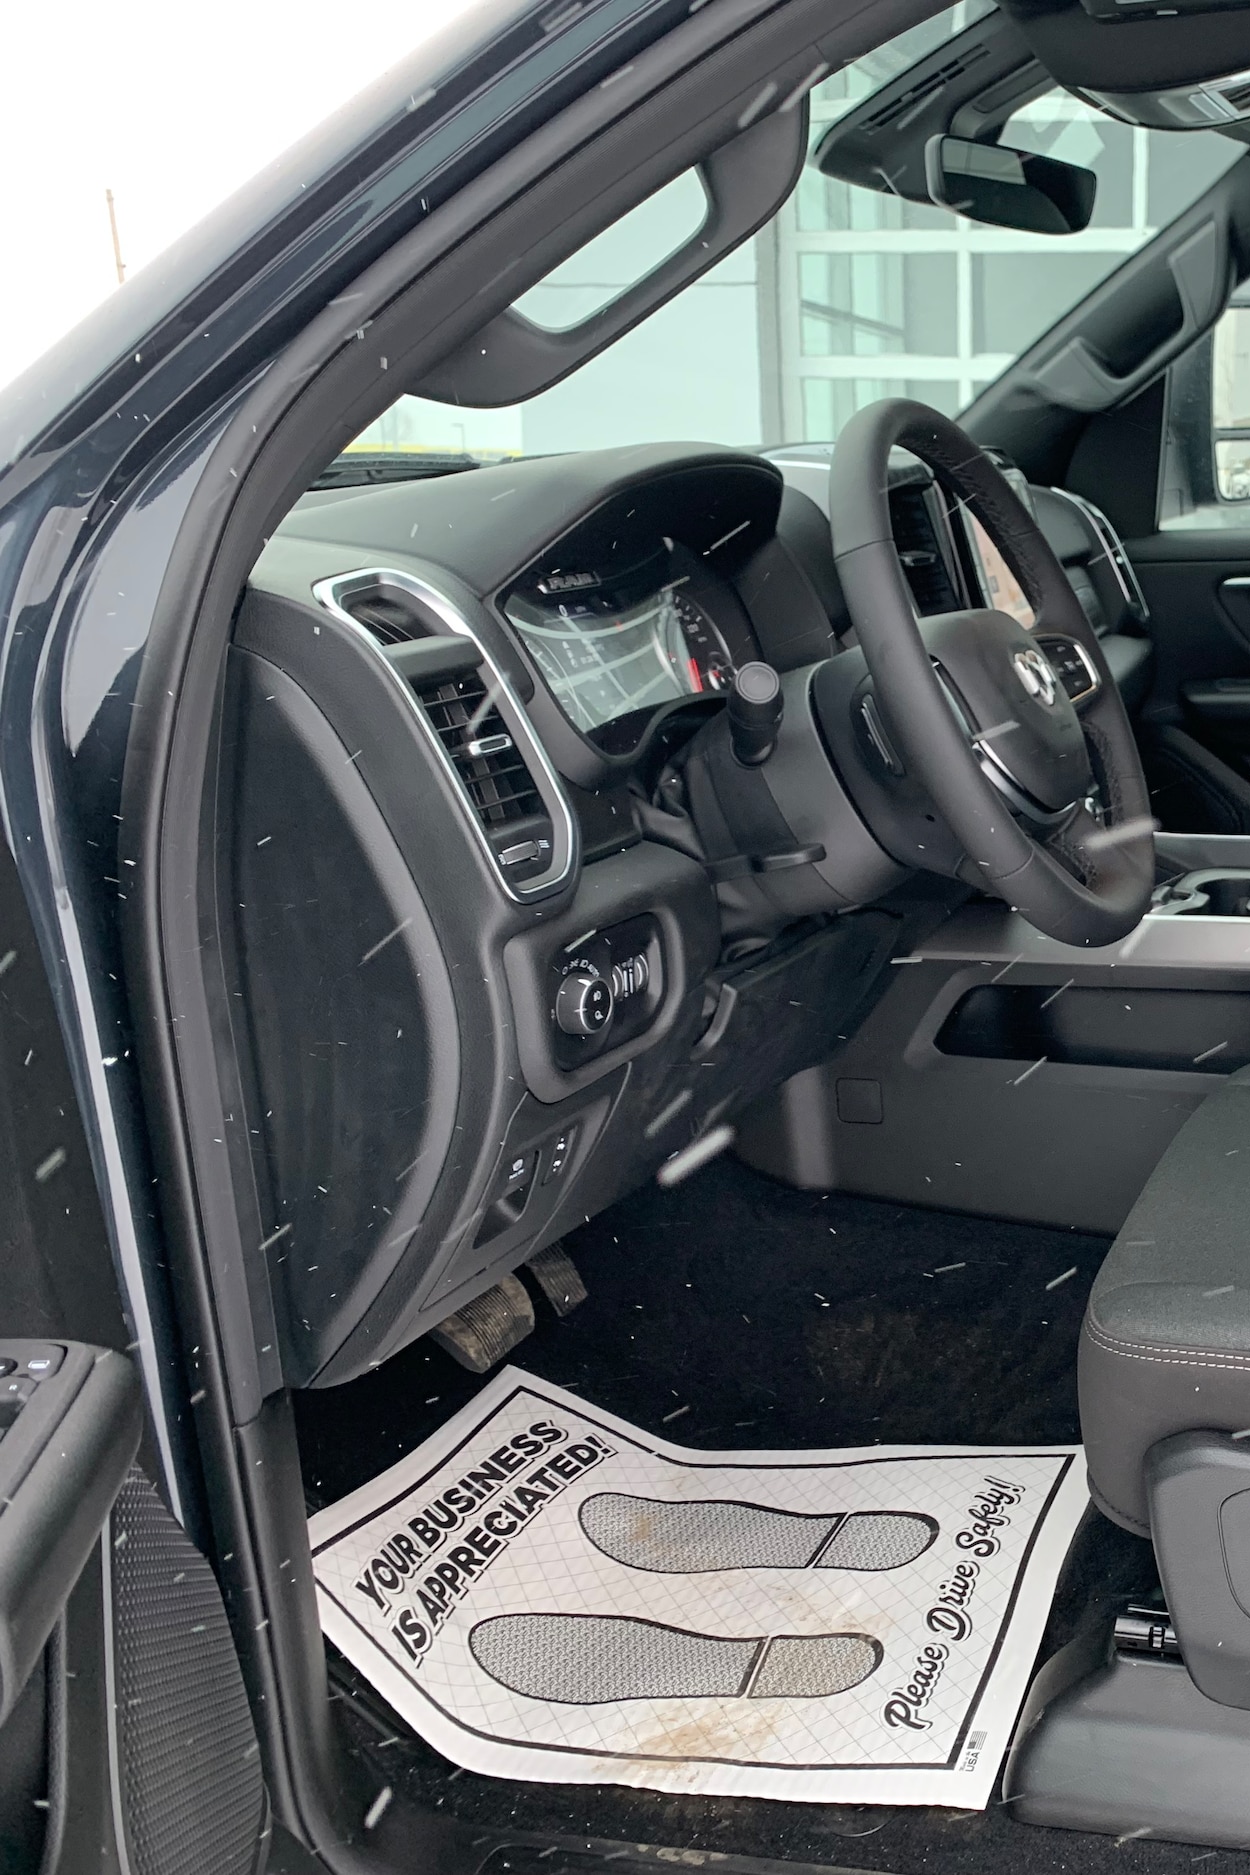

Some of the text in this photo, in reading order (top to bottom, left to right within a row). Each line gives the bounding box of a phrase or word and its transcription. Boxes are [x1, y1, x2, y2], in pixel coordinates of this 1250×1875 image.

[546, 572, 594, 589] RAM
[354, 1420, 568, 1616] YOUR BUSINESS
[391, 1434, 618, 1668] IS APPRECIATED!
[883, 1475, 1025, 1730] Please Drive Safely!
[965, 1751, 980, 1772] USA
